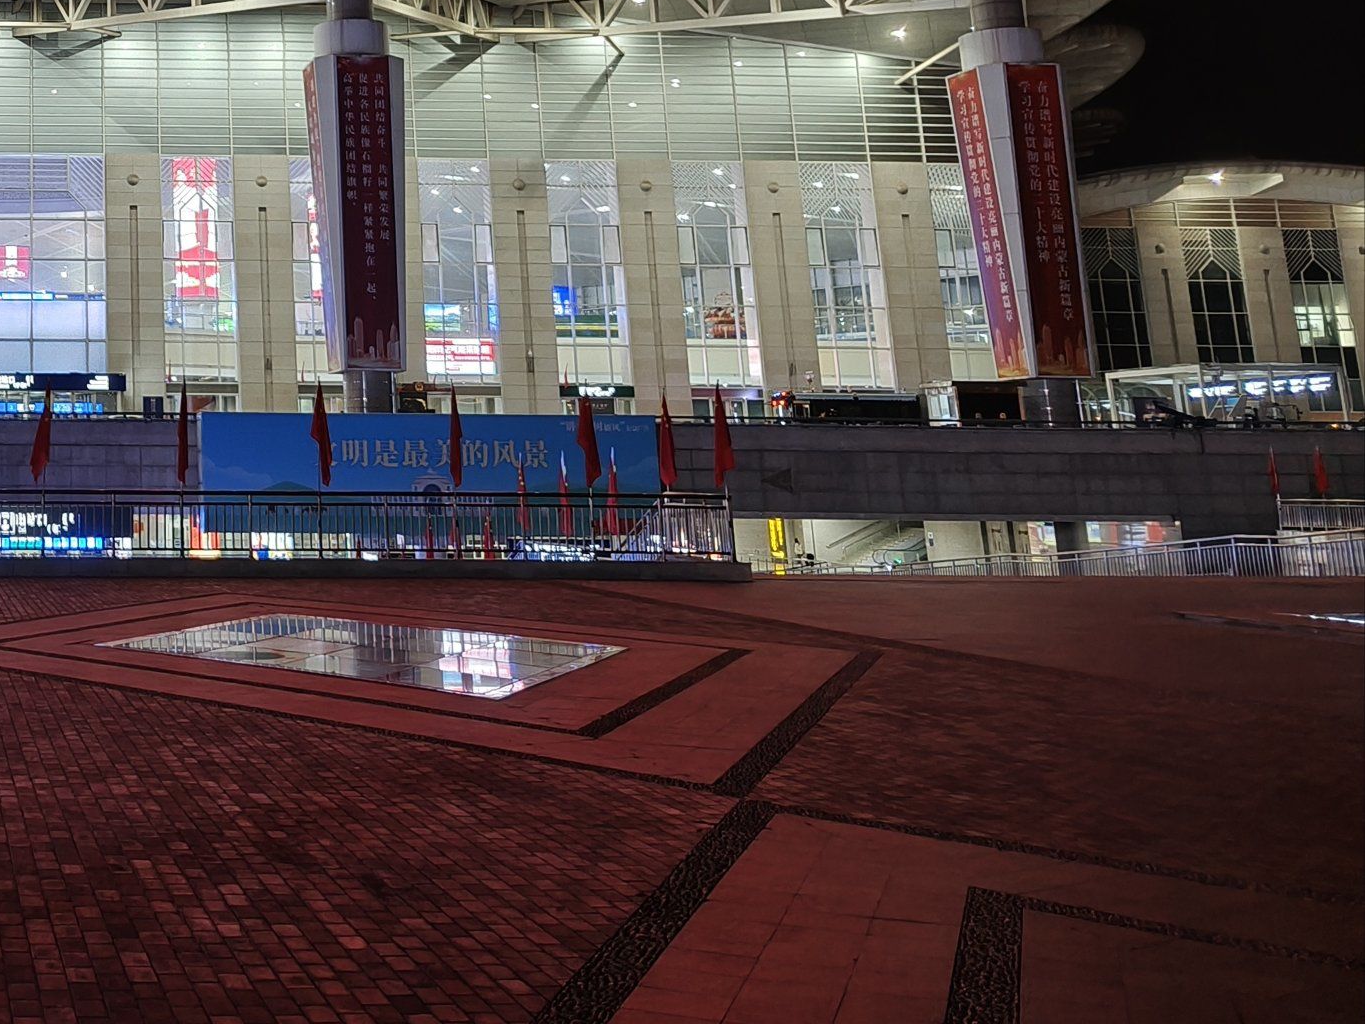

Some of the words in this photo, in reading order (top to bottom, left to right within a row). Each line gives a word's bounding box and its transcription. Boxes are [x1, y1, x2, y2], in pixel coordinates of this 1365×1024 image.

[956, 89, 993, 268] 学习宣传贯彻党的二十大精神
[967, 86, 1013, 322] 奋力谱写新时代建设亮丽内蒙古新篇章
[1018, 80, 1050, 262] 学习宣传贯彻党的二十大精神
[1038, 80, 1074, 321] 奋力谱写新时代建设亮丽内蒙古新篇章
